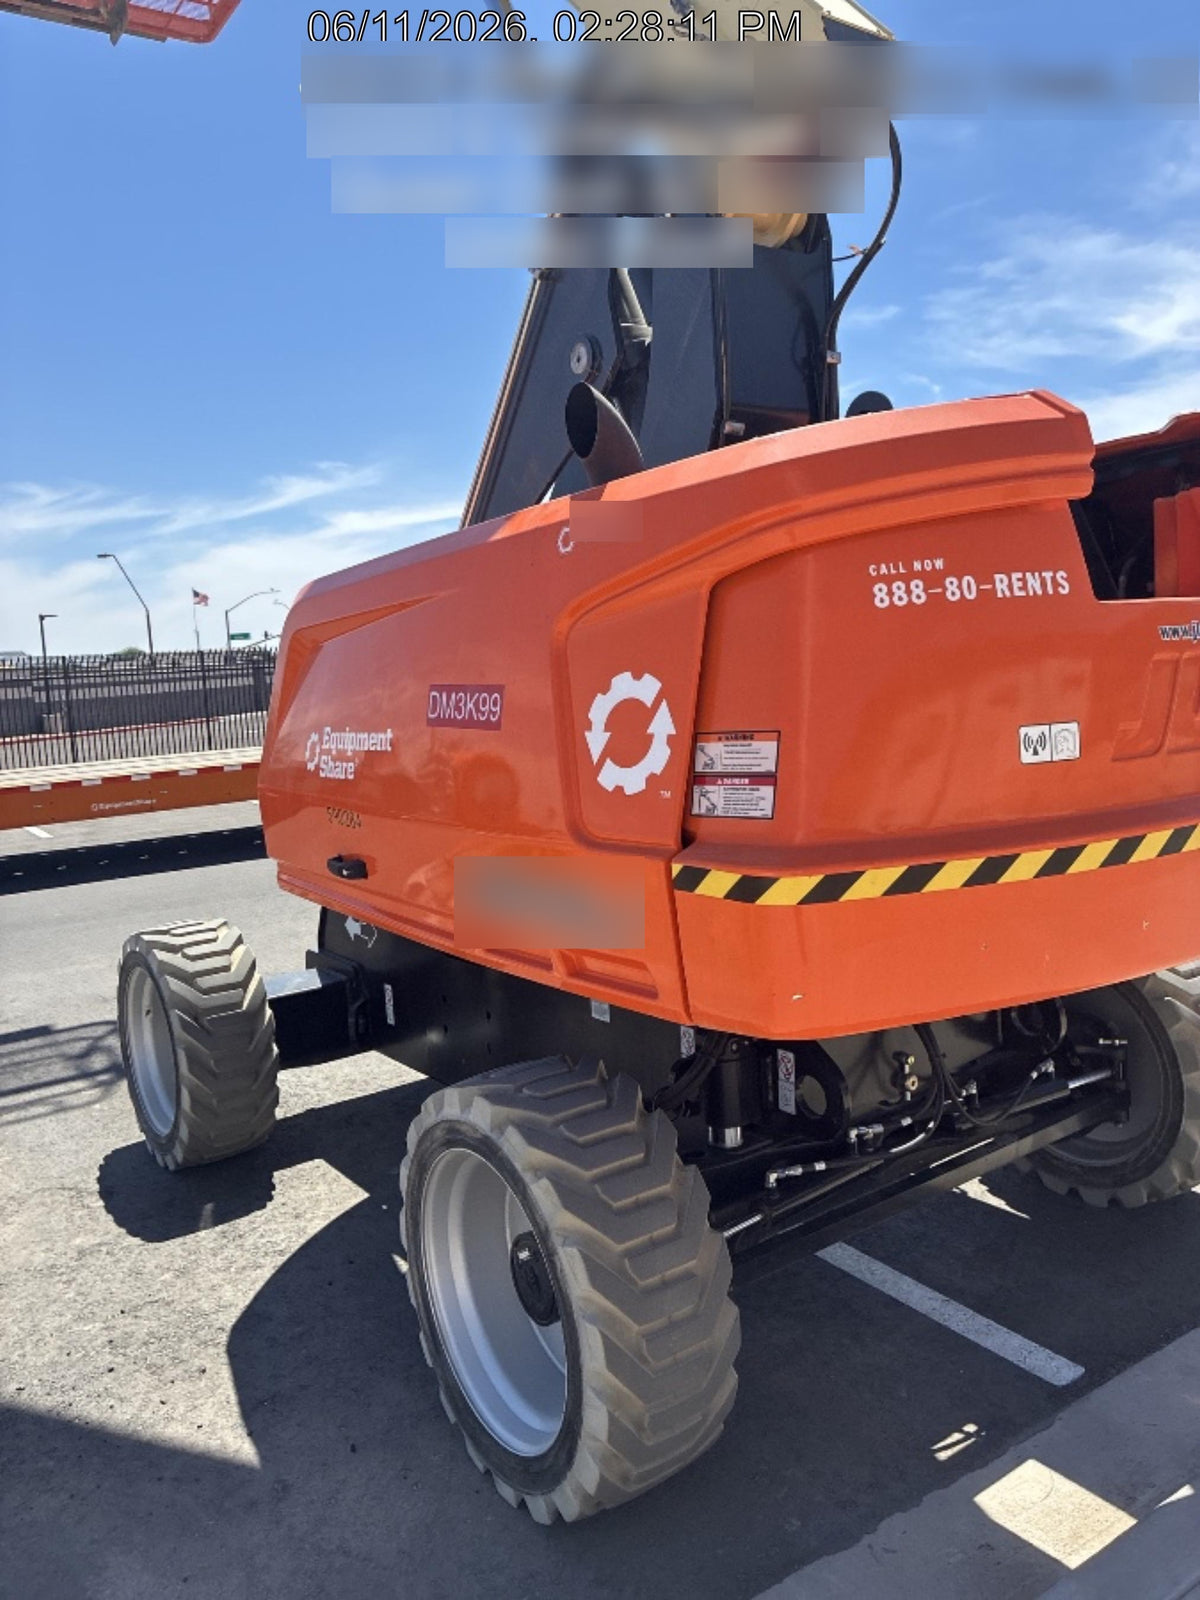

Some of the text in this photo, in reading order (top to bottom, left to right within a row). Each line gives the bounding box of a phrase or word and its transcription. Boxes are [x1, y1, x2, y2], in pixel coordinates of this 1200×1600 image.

[868, 557, 945, 577] CALL NOW
[872, 570, 1071, 609] 888-80-RENTS
[427, 690, 502, 722] DM3K99
[321, 726, 393, 756] Equipment
[319, 754, 355, 780] Share
